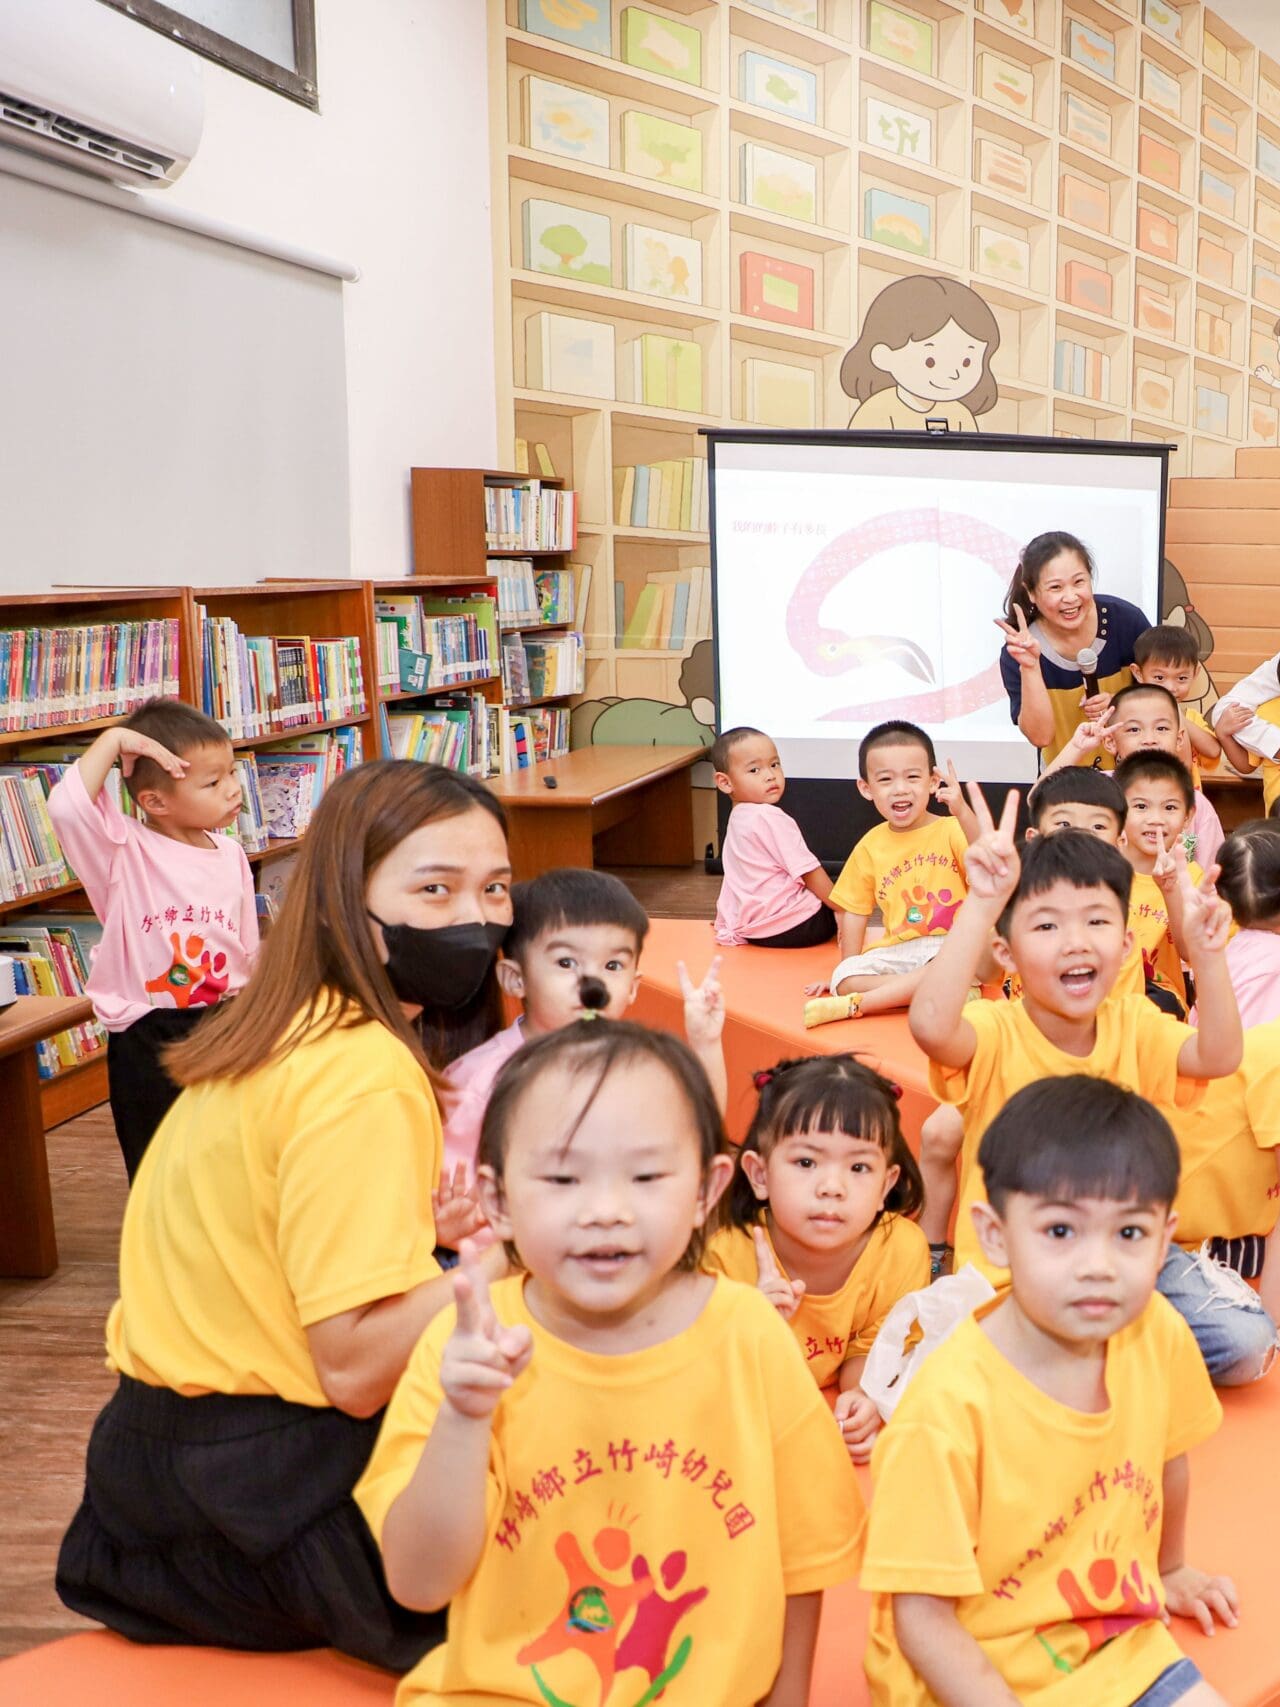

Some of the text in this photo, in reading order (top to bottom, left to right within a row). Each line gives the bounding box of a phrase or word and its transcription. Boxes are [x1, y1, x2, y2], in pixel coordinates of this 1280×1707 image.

[495, 1437, 756, 1554] 竹崎鄉立竹崎幼兒園
